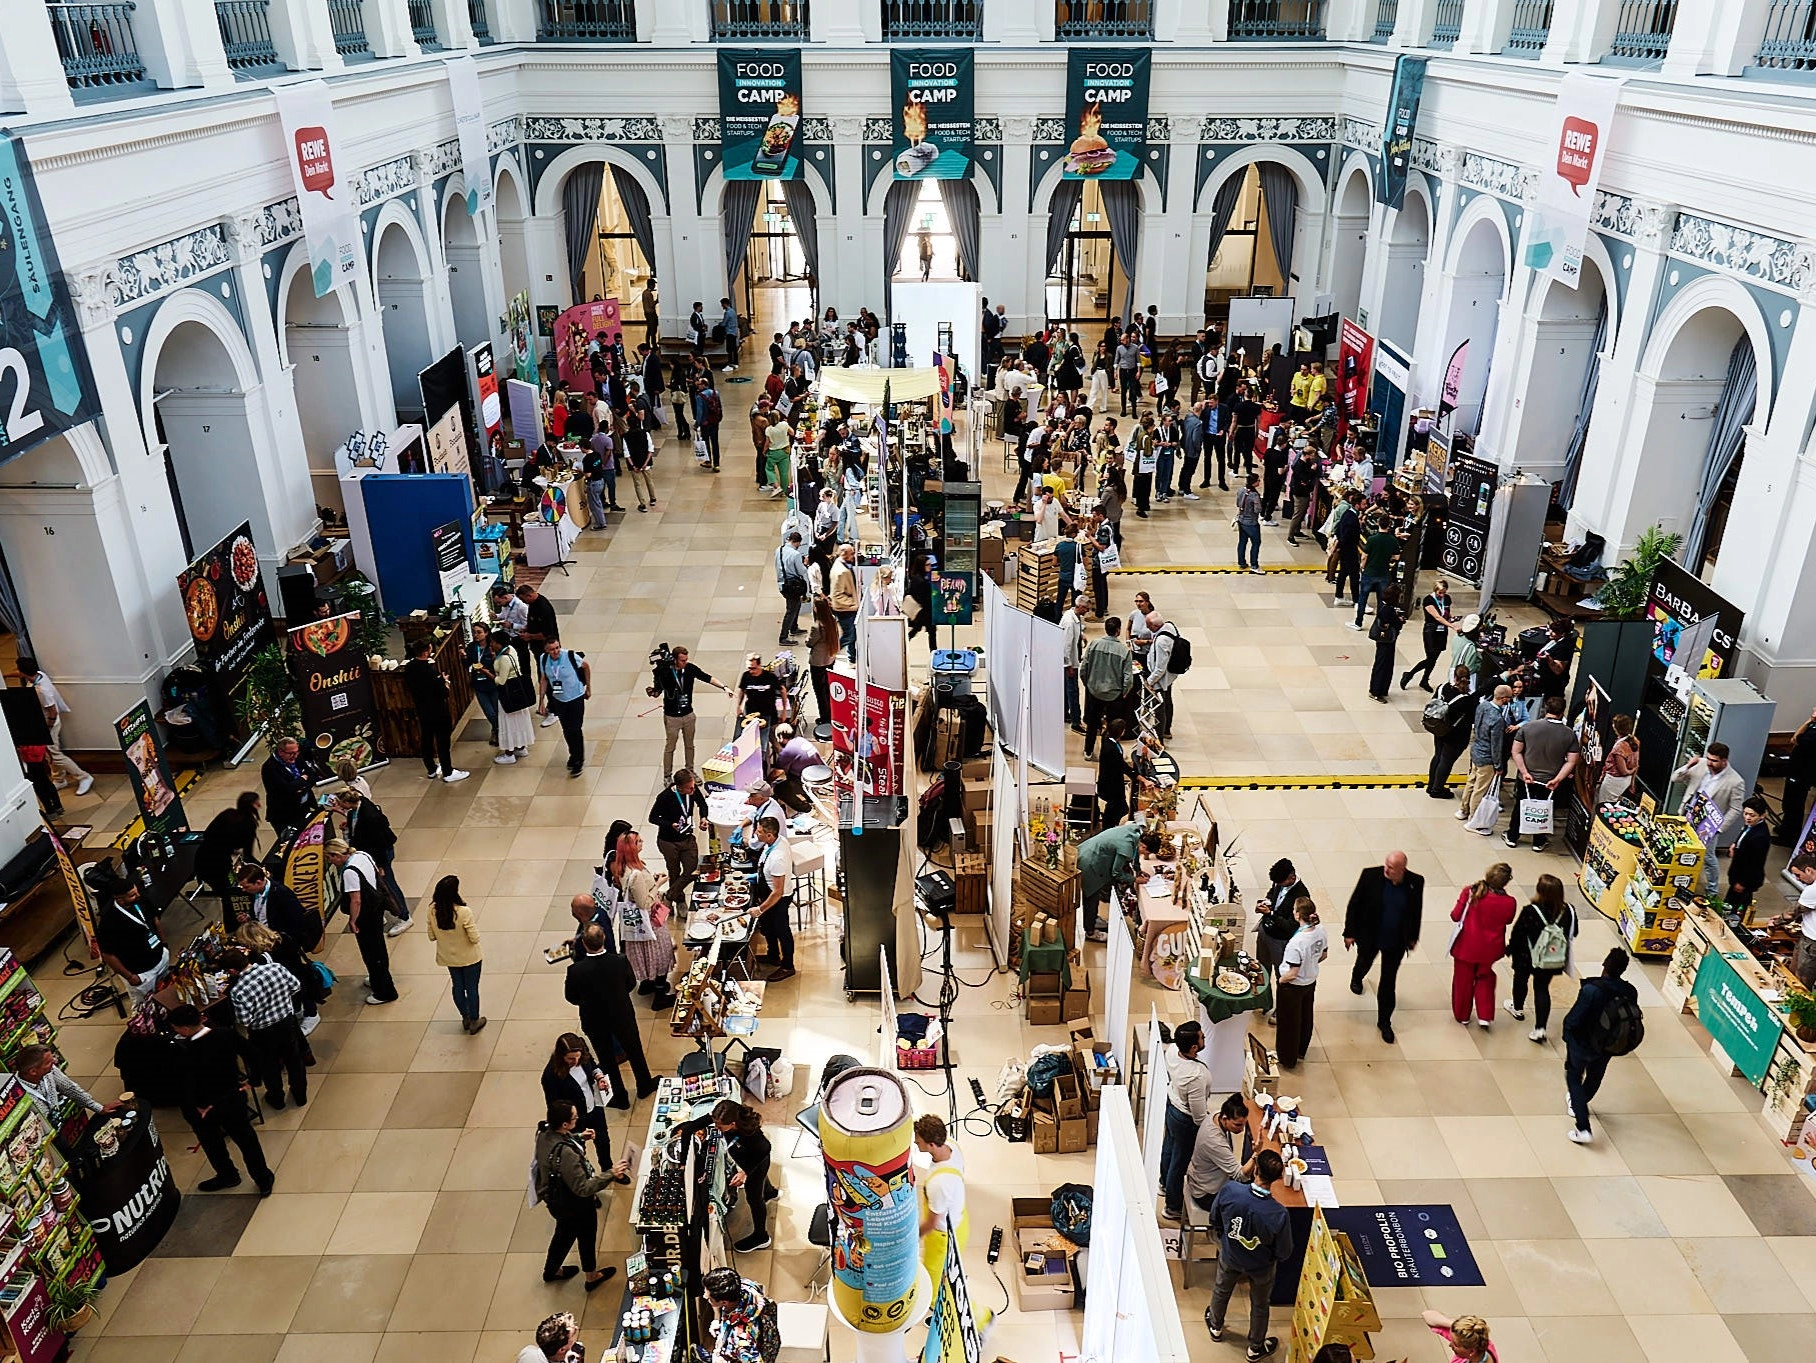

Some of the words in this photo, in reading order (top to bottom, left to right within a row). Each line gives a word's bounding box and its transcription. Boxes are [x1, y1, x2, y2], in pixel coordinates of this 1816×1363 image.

[737, 63, 785, 77] FOOD
[909, 63, 957, 77] FOOD
[1086, 63, 1134, 77] FOOD
[739, 79, 783, 87] INNOVATION
[911, 79, 955, 87] INNOVATION
[1087, 79, 1131, 87] INNOVATION
[737, 89, 785, 103] CAMP
[910, 89, 957, 103] CAMP
[1085, 89, 1132, 103] CAMP
[1564, 130, 1592, 153] REWE
[300, 138, 327, 162] REWE
[1561, 150, 1573, 165] Dein
[1572, 153, 1588, 169] Markt
[304, 163, 316, 178] Dein
[315, 161, 329, 176] Markt
[4, 176, 41, 294] SÄULENGANG
[339, 243, 353, 255] FOOD
[1565, 244, 1581, 259] FOOD
[341, 260, 355, 273] CAMP
[1562, 262, 1577, 275] CAMP
[312, 354, 320, 362] 18
[0, 346, 44, 443] 2
[1679, 412, 1685, 420] 4
[202, 425, 211, 433] 17
[1428, 440, 1447, 464] KEKS
[43, 526, 55, 536] 16
[1101, 557, 1117, 565] CAMP
[223, 611, 246, 640] Onshii
[310, 665, 361, 692] Onshii
[1525, 805, 1549, 815] FOOD
[1524, 816, 1549, 825] CAMP
[232, 901, 252, 912] BIT
[866, 1207, 897, 1218] Entfalte
[866, 1220, 882, 1228] und
[1375, 1211, 1401, 1260] PROPOLIS
[873, 1238, 895, 1248] Inspire
[1165, 1238, 1180, 1253] 25
[1394, 1259, 1409, 1279] BIO
